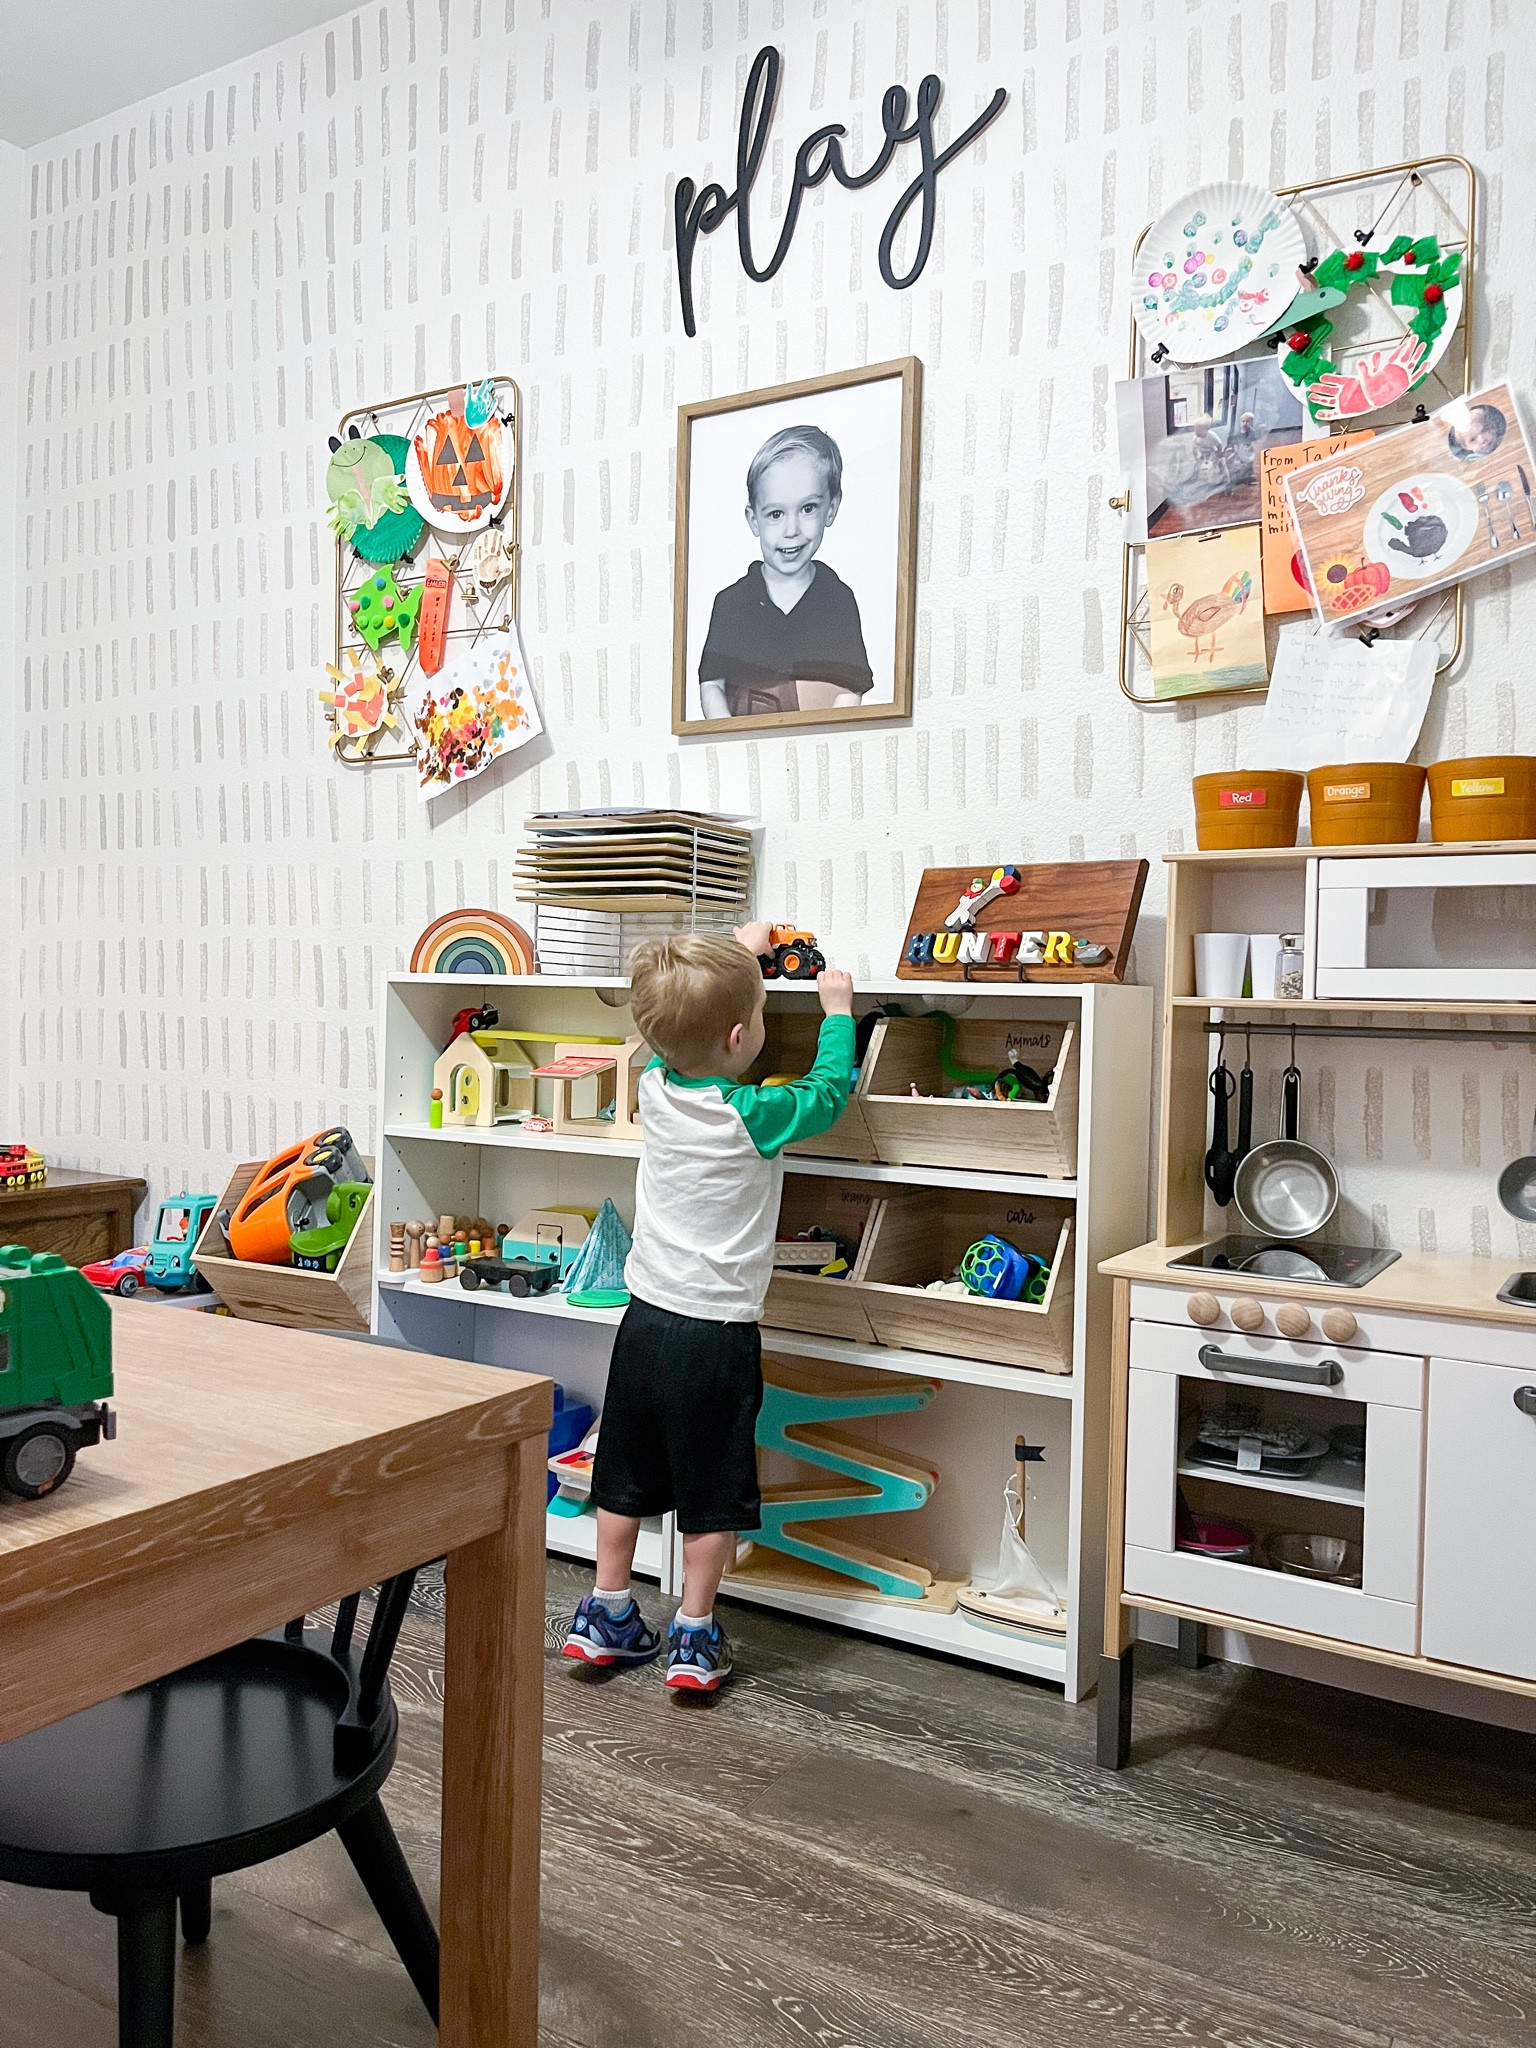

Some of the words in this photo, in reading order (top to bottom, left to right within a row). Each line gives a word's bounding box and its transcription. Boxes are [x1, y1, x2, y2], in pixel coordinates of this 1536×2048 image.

[674, 45, 1007, 338] play
[1263, 448, 1294, 466] From
[1327, 786, 1365, 798] Orange
[1460, 780, 1495, 793] Yellow
[1232, 792, 1253, 804] Red
[905, 931, 1074, 964] HUNTER
